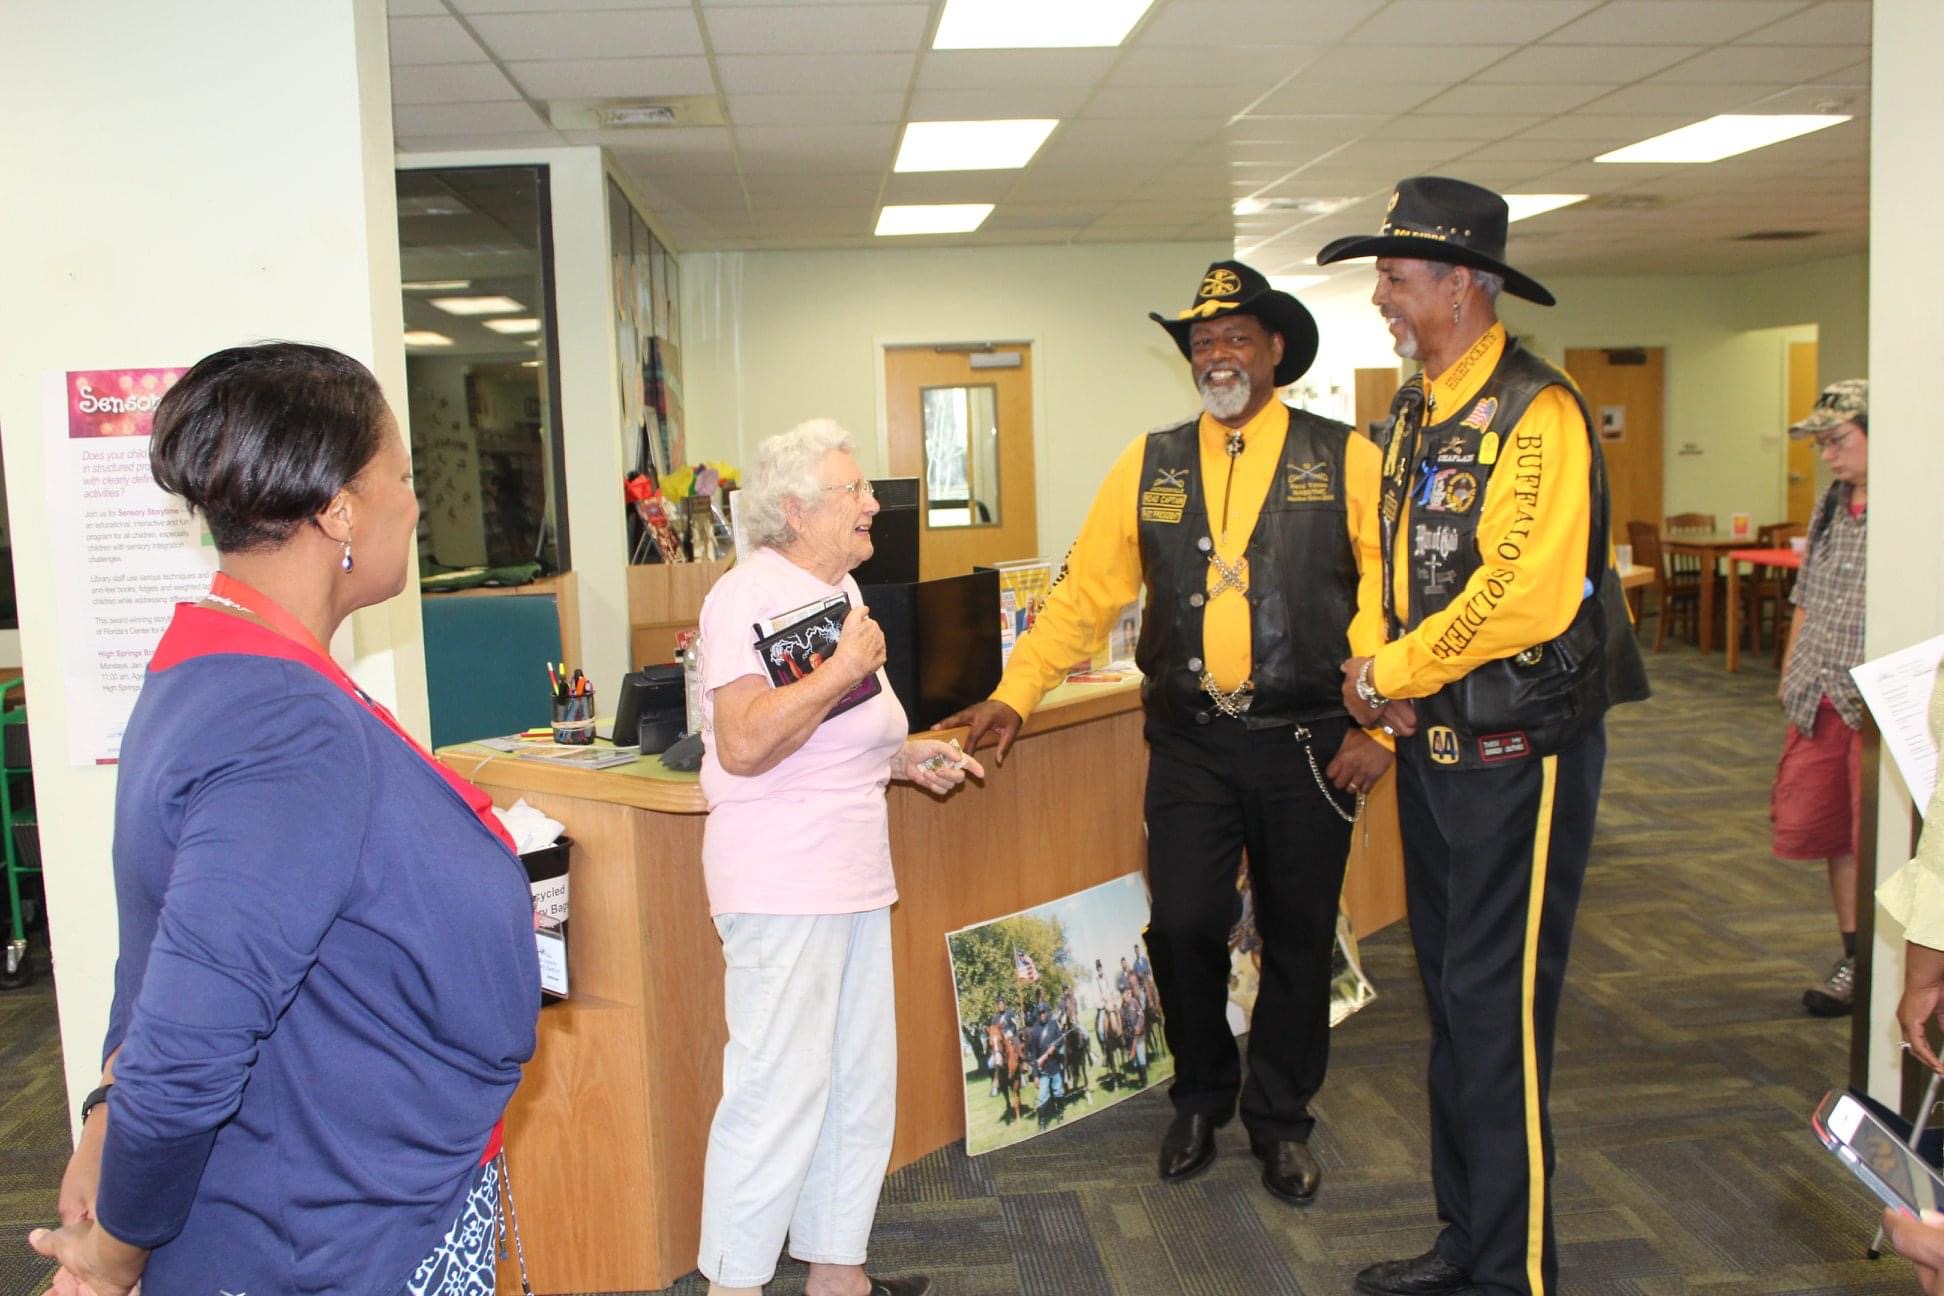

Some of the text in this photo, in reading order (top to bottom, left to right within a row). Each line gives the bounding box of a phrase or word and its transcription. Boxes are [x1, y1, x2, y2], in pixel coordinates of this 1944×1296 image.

[82, 449, 148, 464] Does your child
[92, 462, 134, 473] structured
[83, 475, 100, 486] with
[102, 474, 129, 488] clearly
[83, 487, 126, 499] activities?
[1497, 433, 1543, 561] BUFFALO
[108, 509, 117, 517] for
[118, 508, 145, 519] Sensory
[147, 507, 179, 518] Storytime
[133, 519, 165, 528] interactive
[166, 518, 179, 526] and
[180, 518, 189, 526] fun
[86, 532, 112, 542] program
[114, 531, 122, 539] for
[123, 531, 131, 539] all
[159, 529, 189, 541] especially
[88, 540, 184, 553] children with sensory integration
[90, 571, 209, 584] Library staff use various techniques and
[160, 583, 173, 592] and
[174, 582, 201, 593] weighted
[92, 597, 116, 606] children
[118, 596, 133, 605] while
[134, 595, 168, 606] addressing
[95, 616, 106, 625] This
[96, 627, 102, 636] of
[103, 626, 129, 636] Florida's
[130, 626, 151, 635] Center
[151, 626, 160, 634] for
[98, 649, 115, 660] High
[115, 648, 142, 660] Springs
[102, 673, 118, 682] 11:00
[102, 683, 118, 694] High
